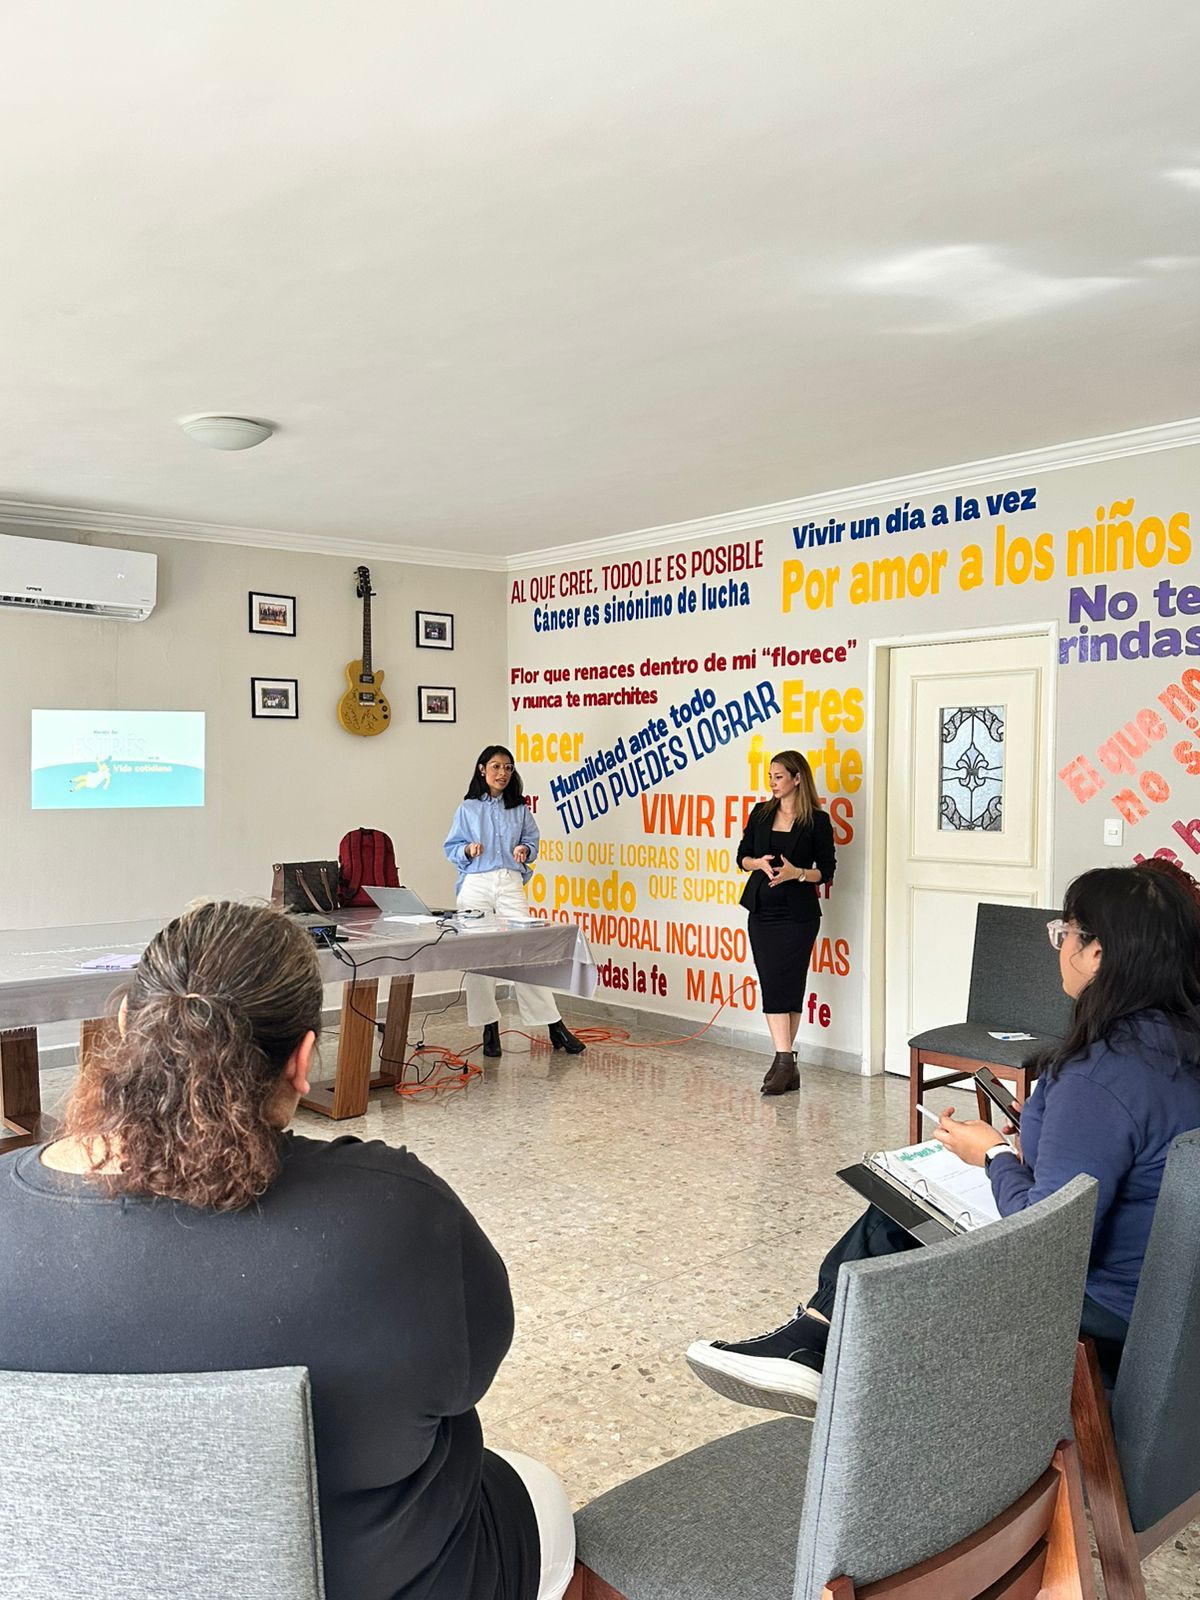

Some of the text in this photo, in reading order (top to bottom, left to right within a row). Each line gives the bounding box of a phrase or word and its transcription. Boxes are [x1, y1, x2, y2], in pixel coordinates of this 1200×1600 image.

[793, 487, 1037, 550] Vivir un día a la vez
[511, 539, 764, 604] AL QUE CREE, TODO LE ES POSIBLE
[782, 498, 1192, 613] Por amor a los niños
[534, 578, 751, 633] Cáncer es sinónimo de lucha
[1068, 579, 1200, 624] No te
[511, 638, 857, 685] Flor que renaces dentro de mi “florece”
[1059, 621, 1200, 664] rindas
[512, 686, 658, 711] y nunca te marchites
[783, 679, 865, 734] Eres
[515, 724, 584, 763] hacer
[550, 687, 716, 802] Humildad ante todo
[556, 680, 782, 835] TU LO PUEDES LOGRAR
[1058, 753, 1108, 805] El
[1096, 707, 1168, 777] que
[641, 793, 715, 838] VIVIR
[1111, 770, 1171, 826] no
[539, 840, 730, 874] RES LO QUE LOGRAS SI NO
[555, 870, 637, 912] puedo
[649, 875, 678, 900] QUE
[666, 922, 747, 963] INCLUSO
[632, 961, 647, 993] la
[650, 964, 668, 997] fe
